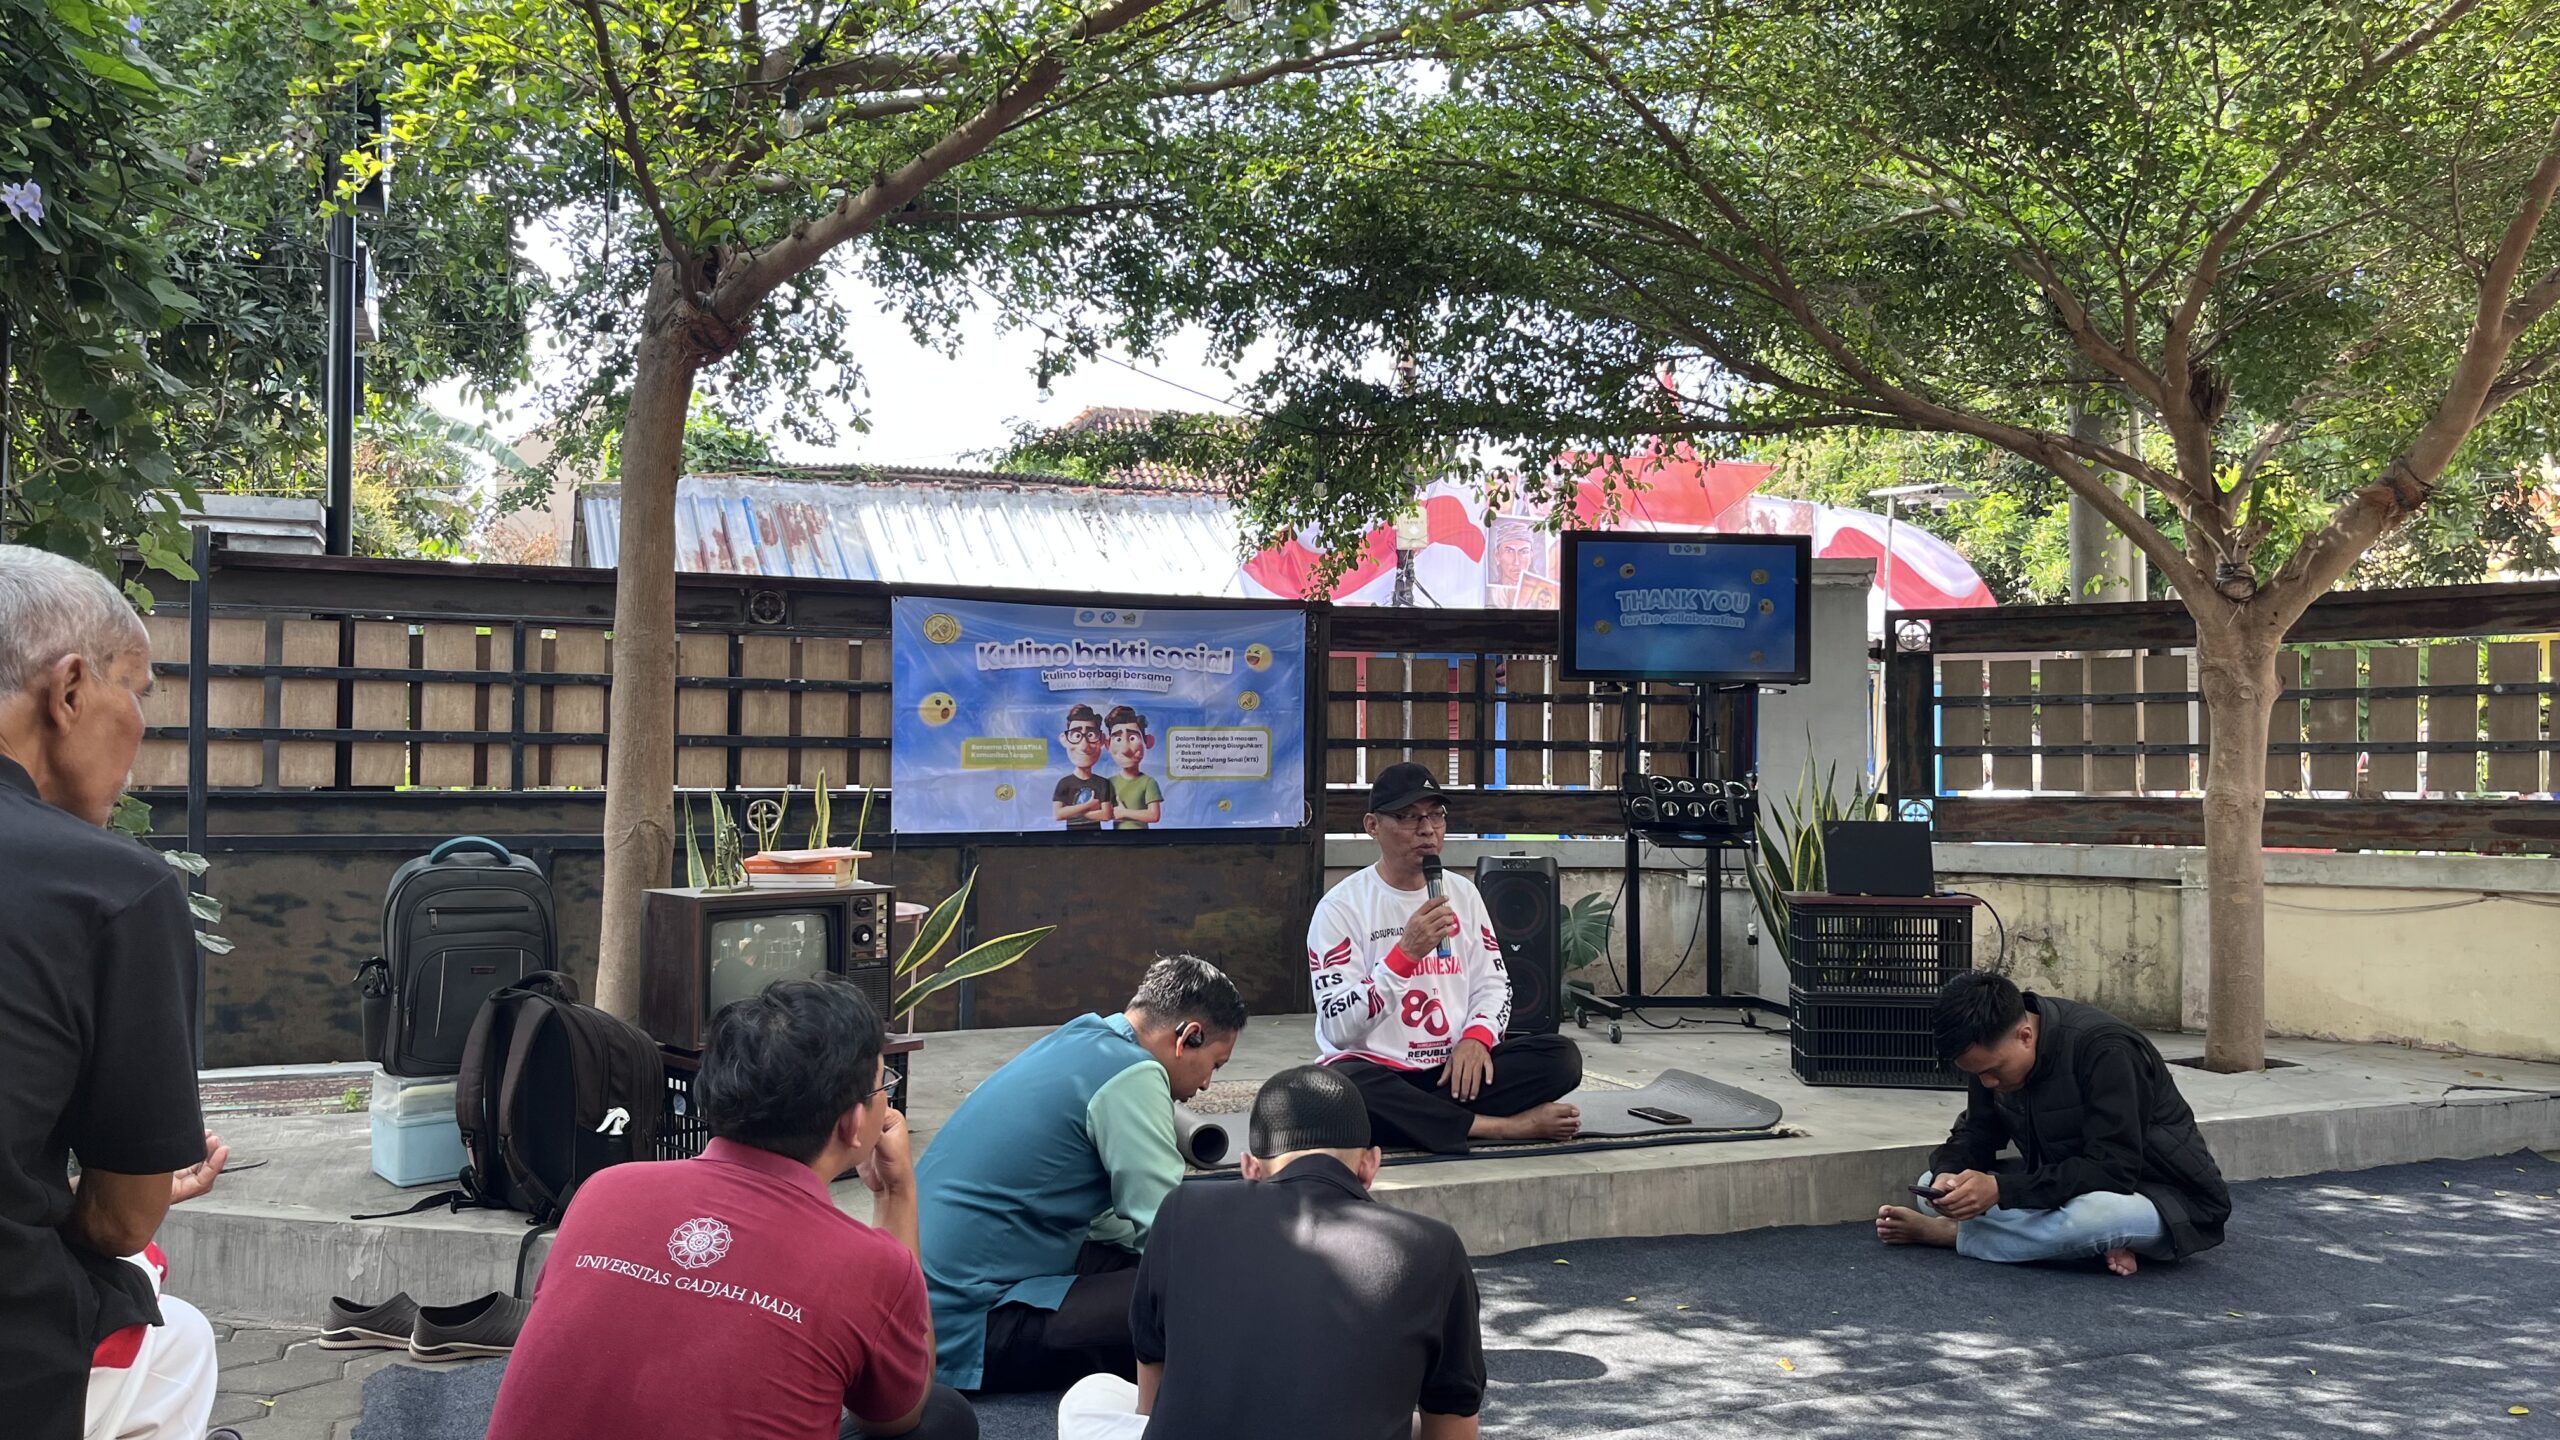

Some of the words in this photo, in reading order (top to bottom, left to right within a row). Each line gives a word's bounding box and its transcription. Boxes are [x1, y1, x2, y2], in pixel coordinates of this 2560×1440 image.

[1616, 588, 1697, 612] THANK
[1699, 590, 1750, 613] YOU
[1620, 613, 1641, 627] for
[1641, 613, 1661, 625] the
[1662, 612, 1745, 628] collaboration
[978, 641, 1070, 669] Kulino
[1075, 641, 1147, 666] bakti
[1152, 645, 1231, 673] sosial
[1043, 670, 1077, 681] kulino
[1079, 669, 1122, 682] berbagi
[1123, 670, 1173, 682] bersama
[575, 1254, 672, 1286] UNIVERSITAS
[675, 1276, 747, 1302] GADJAH
[750, 1289, 803, 1324] MADA
